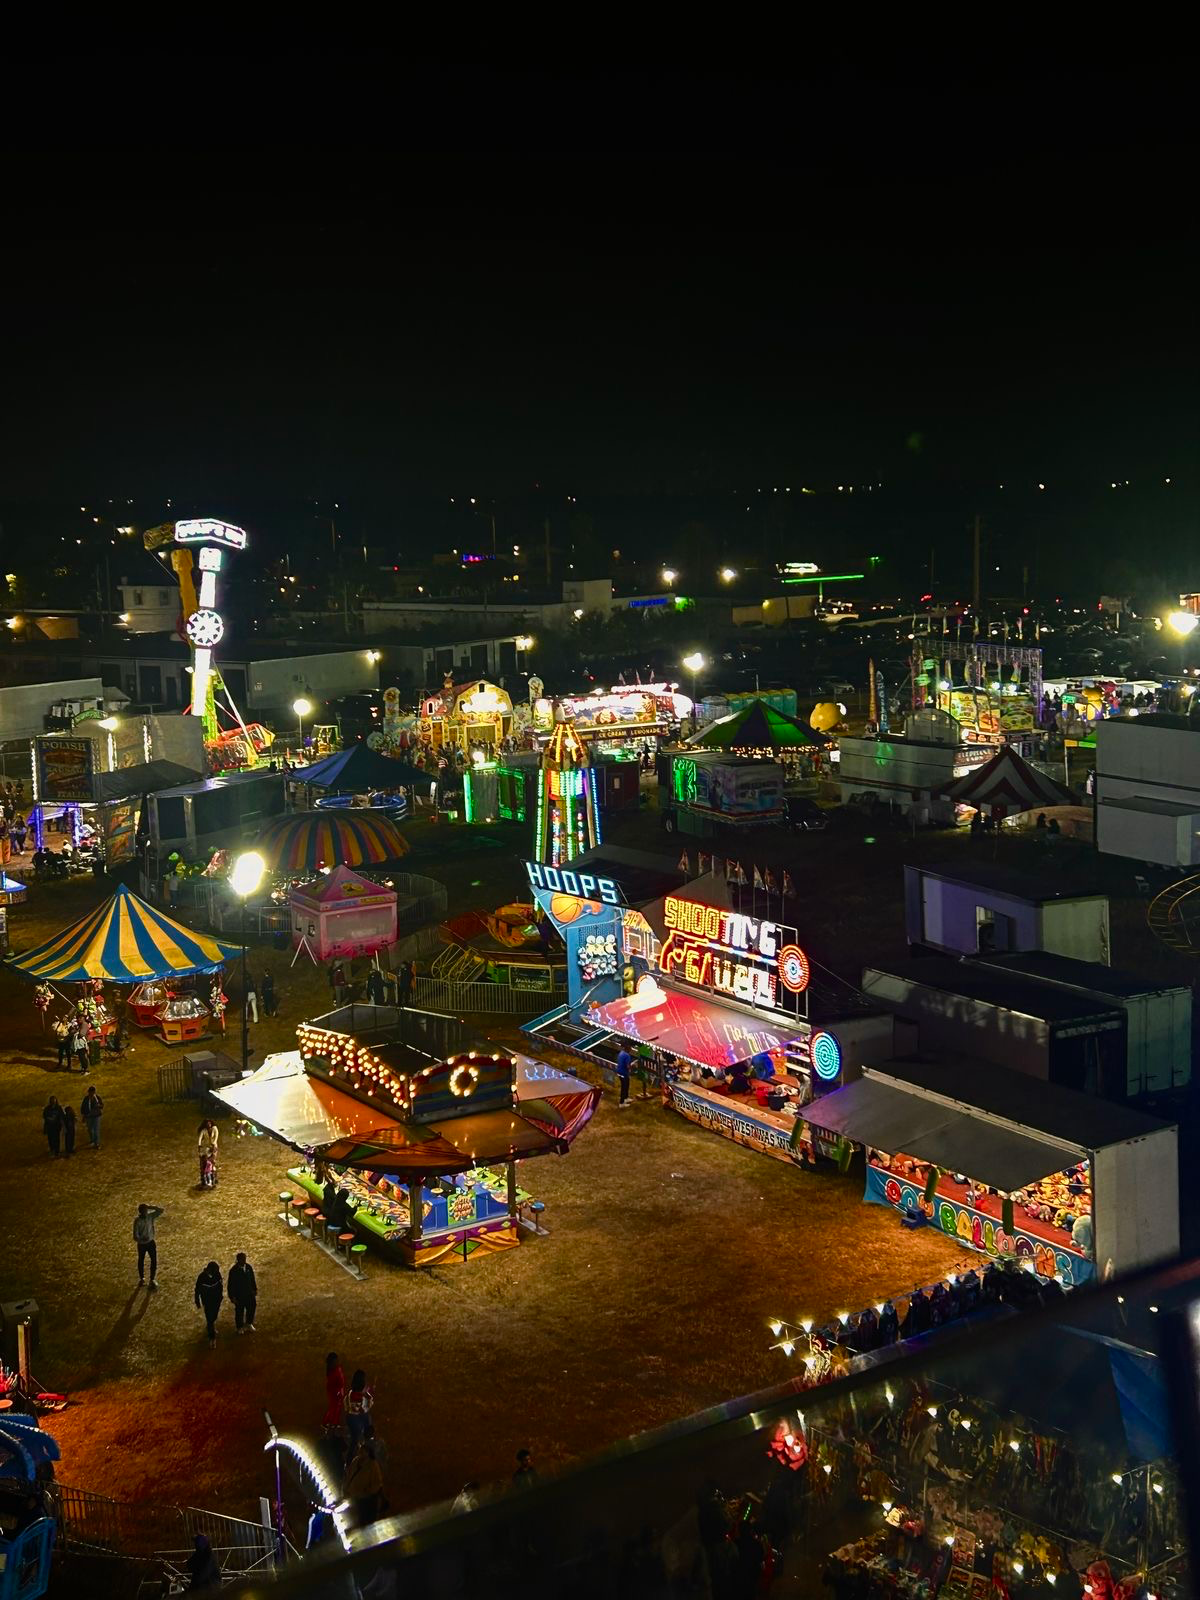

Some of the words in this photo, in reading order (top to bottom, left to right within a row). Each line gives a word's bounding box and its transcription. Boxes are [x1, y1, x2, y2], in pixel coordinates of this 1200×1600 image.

[42, 741, 87, 751] POLISH
[525, 862, 618, 904] HOOPS
[664, 896, 778, 957] SHOOTING
[732, 1117, 754, 1137] WEST
[755, 1126, 775, 1147] WAS
[939, 1202, 1074, 1290] BALLOONS
